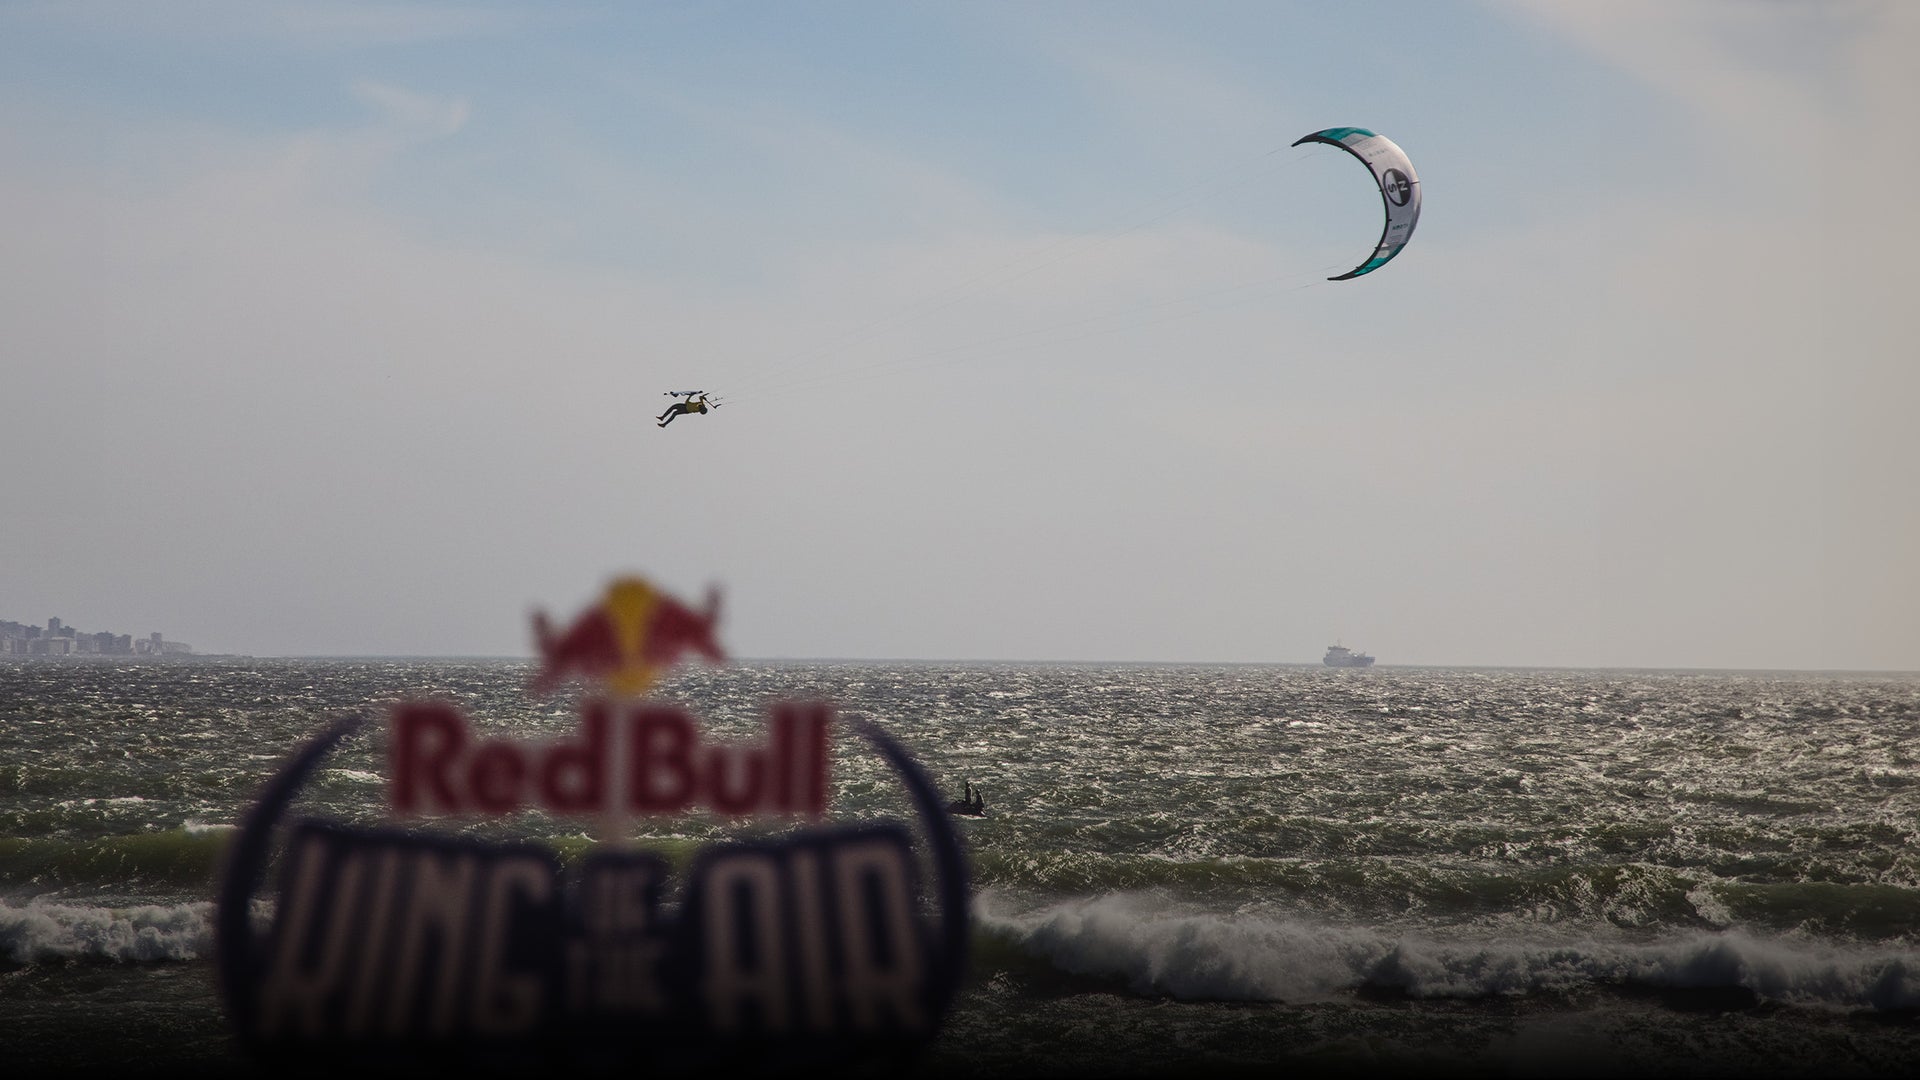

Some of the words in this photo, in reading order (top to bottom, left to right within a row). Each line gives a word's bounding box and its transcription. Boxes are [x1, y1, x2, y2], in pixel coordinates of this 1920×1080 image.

[391, 701, 609, 817] Red
[629, 703, 831, 818] Bull
[704, 837, 934, 1040] AIR
